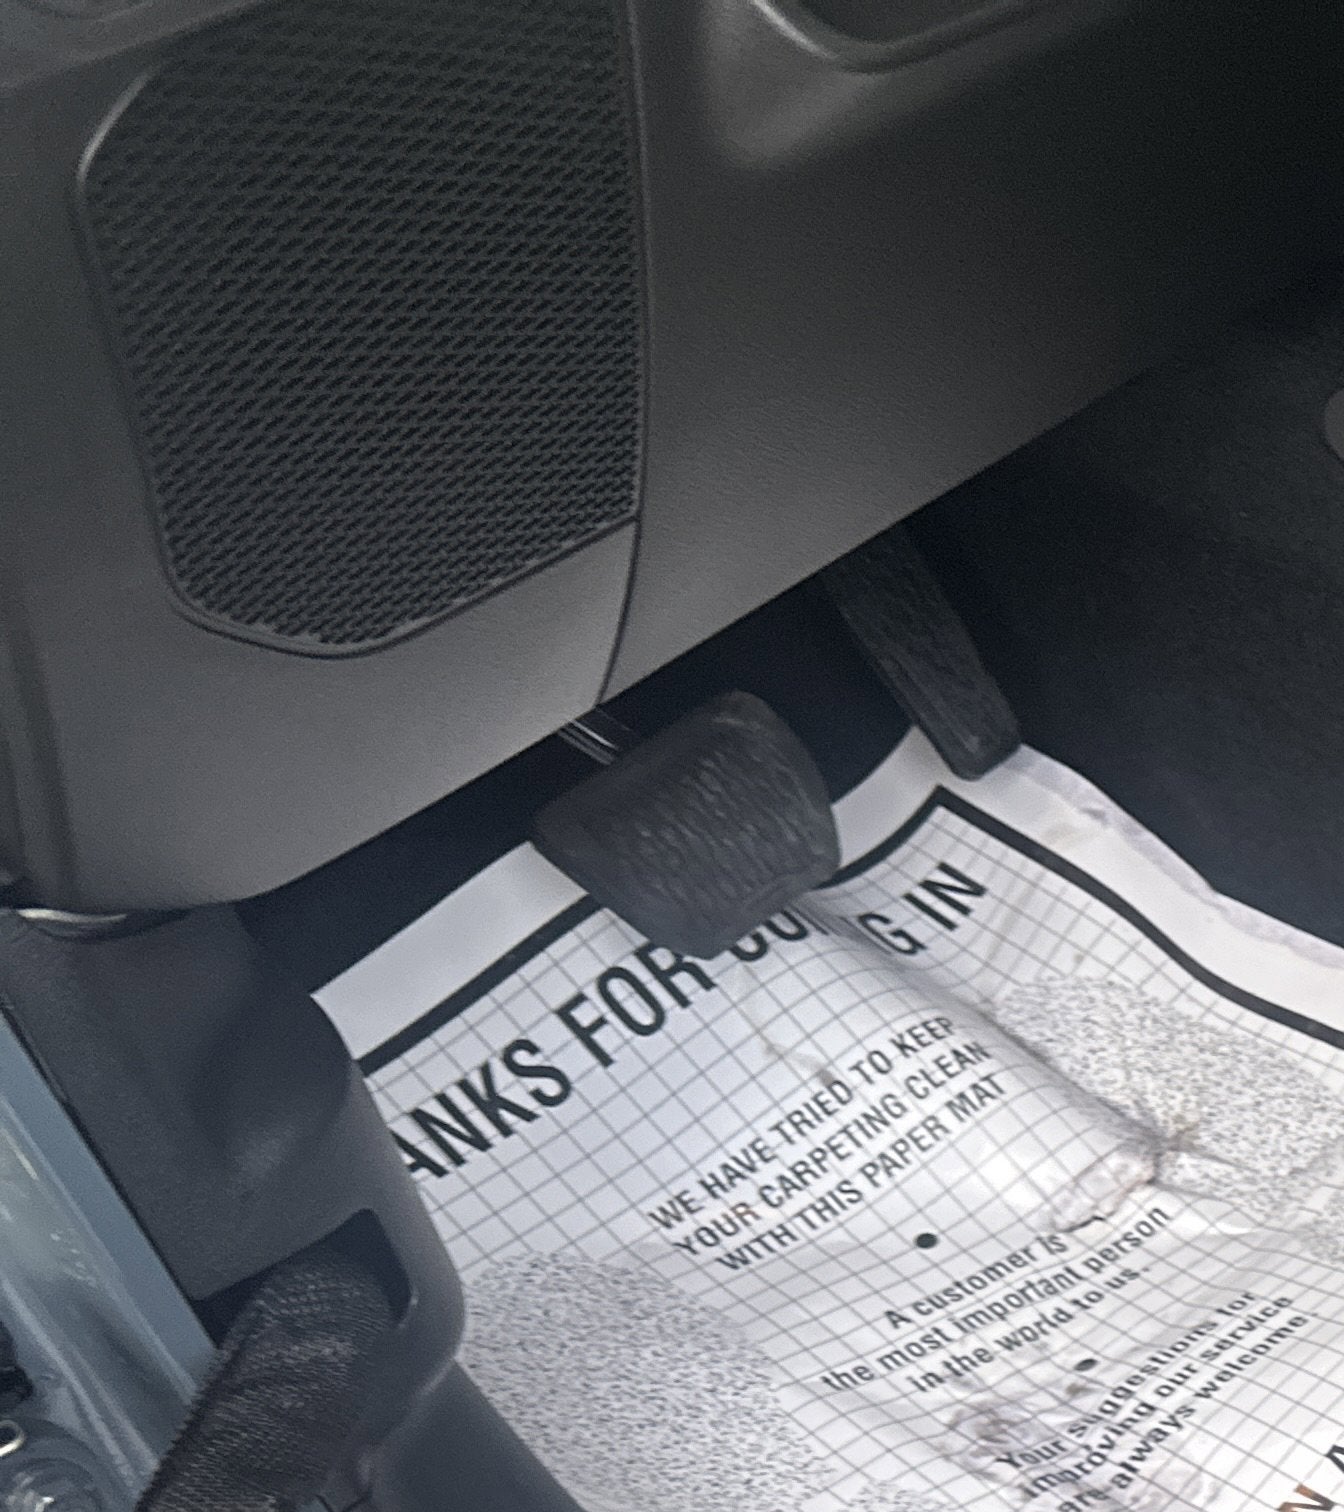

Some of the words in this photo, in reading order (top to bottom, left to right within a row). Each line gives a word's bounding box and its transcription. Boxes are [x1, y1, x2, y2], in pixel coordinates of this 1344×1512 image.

[391, 1038, 572, 1178] ANKS
[553, 940, 717, 1068] FOR
[901, 861, 989, 932] IN
[648, 1189, 703, 1230] WE
[698, 1137, 777, 1200] HAVE
[769, 1079, 854, 1146] TRIED
[849, 1049, 894, 1086] TO
[889, 1016, 957, 1059] KEEP
[672, 1201, 761, 1257] YOUR
[757, 1092, 909, 1209] CARPETING
[903, 1041, 992, 1100] CLEAN
[715, 1222, 799, 1271] WITH
[796, 1178, 865, 1231] THIS
[858, 1114, 951, 1189] PAPER
[945, 1073, 1007, 1123] MAT
[822, 1361, 875, 1392] the
[876, 1326, 953, 1372] most
[952, 1265, 1084, 1336] important
[1081, 1206, 1172, 1275] person
[884, 1309, 909, 1329] A
[912, 1245, 1038, 1318] customer
[1035, 1232, 1069, 1257] is
[907, 1370, 945, 1393] in
[944, 1347, 995, 1378] the
[994, 1306, 1075, 1352] world
[1070, 1289, 1105, 1311] to
[1104, 1266, 1149, 1290] us.
[996, 1438, 1069, 1470] Your
[1067, 1318, 1218, 1438] suggestions
[1214, 1292, 1256, 1317] for
[1019, 1399, 1157, 1498] improving
[1155, 1362, 1198, 1398] our
[1200, 1297, 1294, 1361] service
[1110, 1405, 1196, 1489] always
